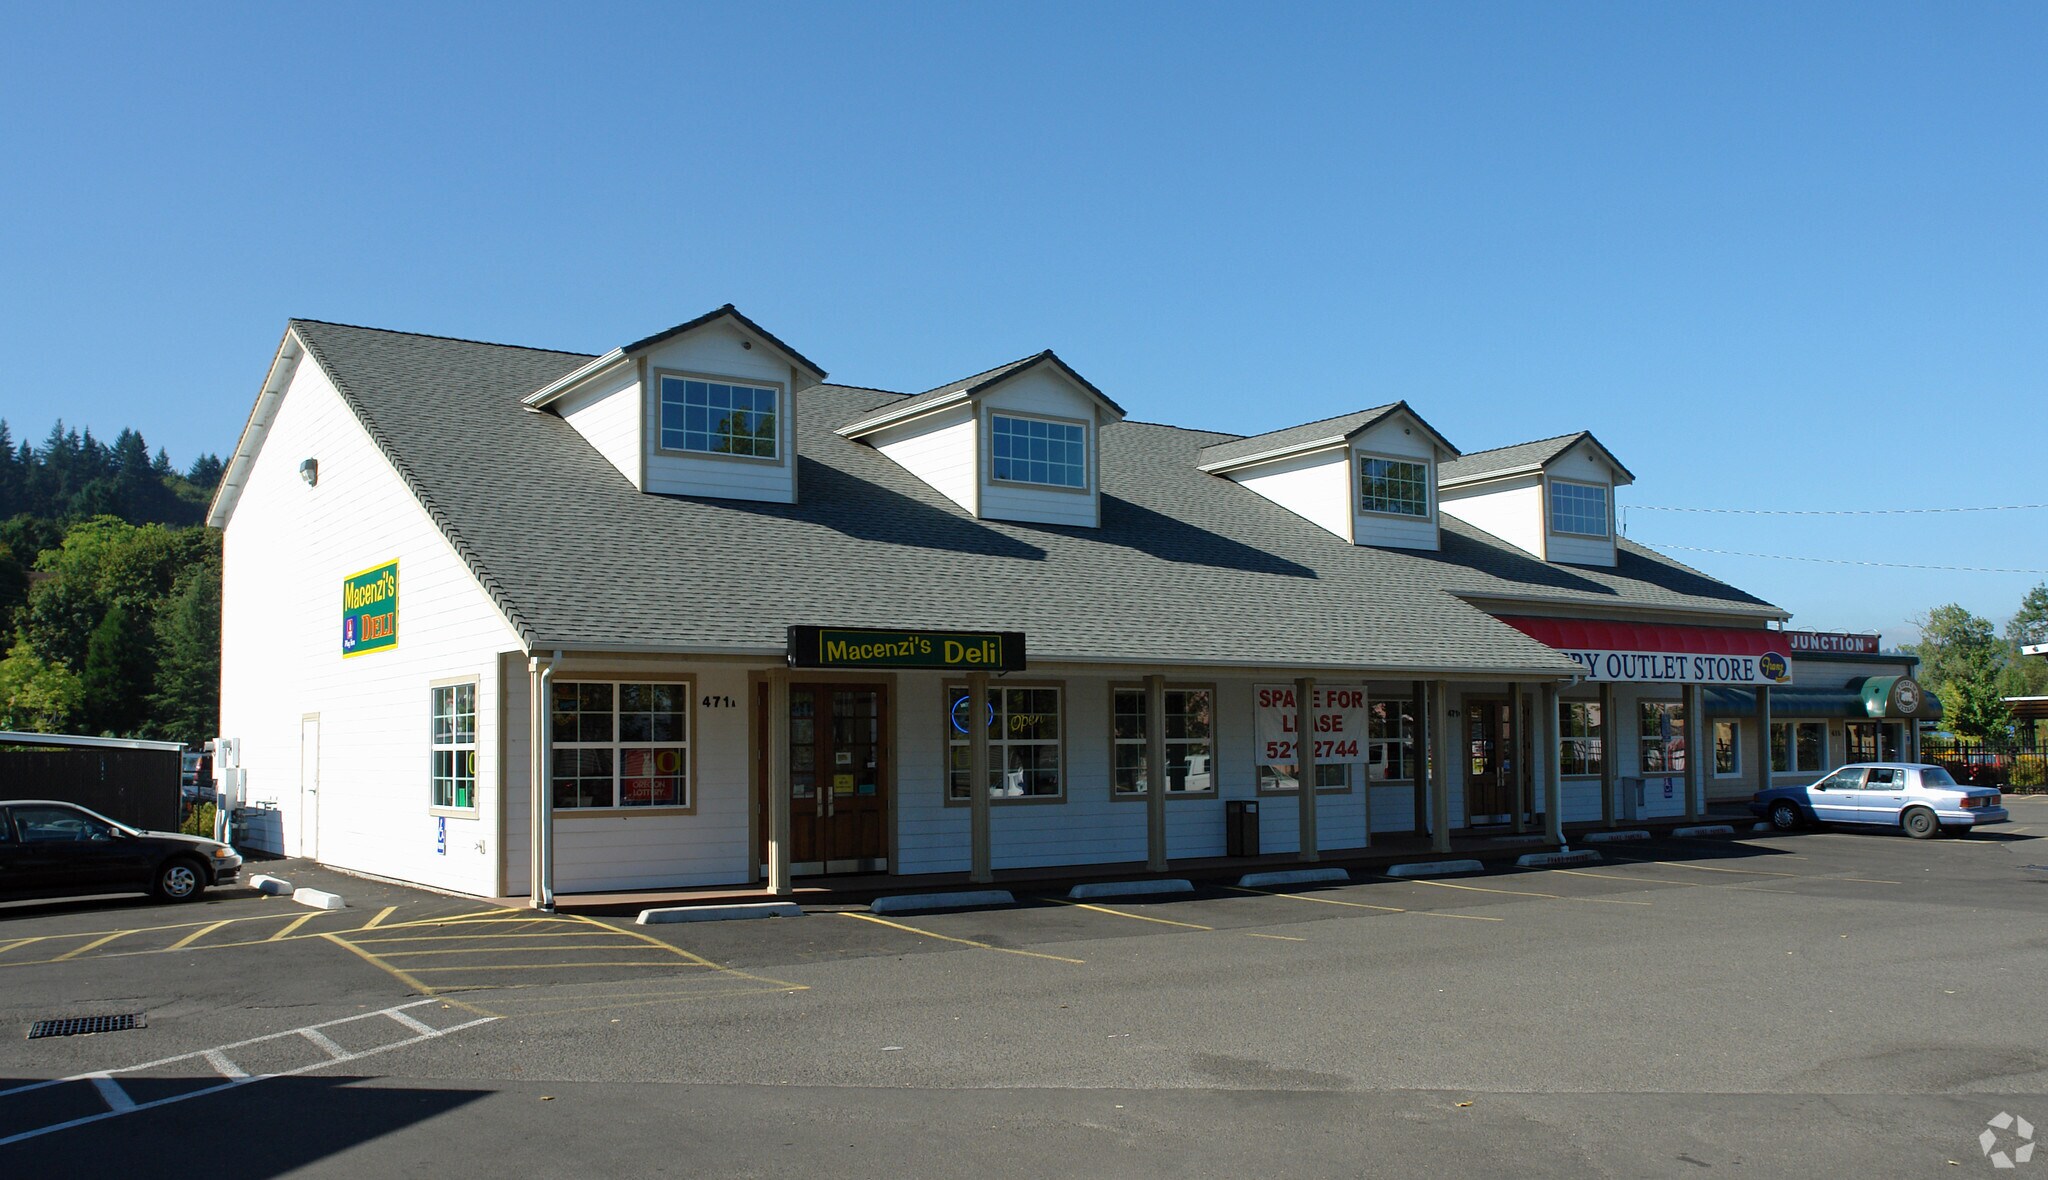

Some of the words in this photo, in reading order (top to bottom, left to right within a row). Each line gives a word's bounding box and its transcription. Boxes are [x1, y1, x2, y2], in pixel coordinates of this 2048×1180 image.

[344, 570, 395, 612] Macenzi's
[361, 612, 394, 642] DELI
[826, 636, 932, 662] Macenzi's
[944, 640, 997, 664] Deli
[1791, 634, 1865, 652] JUNCTION
[1606, 653, 1689, 680] OUTLET
[1694, 656, 1755, 682] STORE
[1259, 689, 1321, 708] SPAE
[1327, 690, 1364, 709] FOR
[1282, 714, 1344, 733] LSE
[632, 788, 666, 797] LOTTRY
